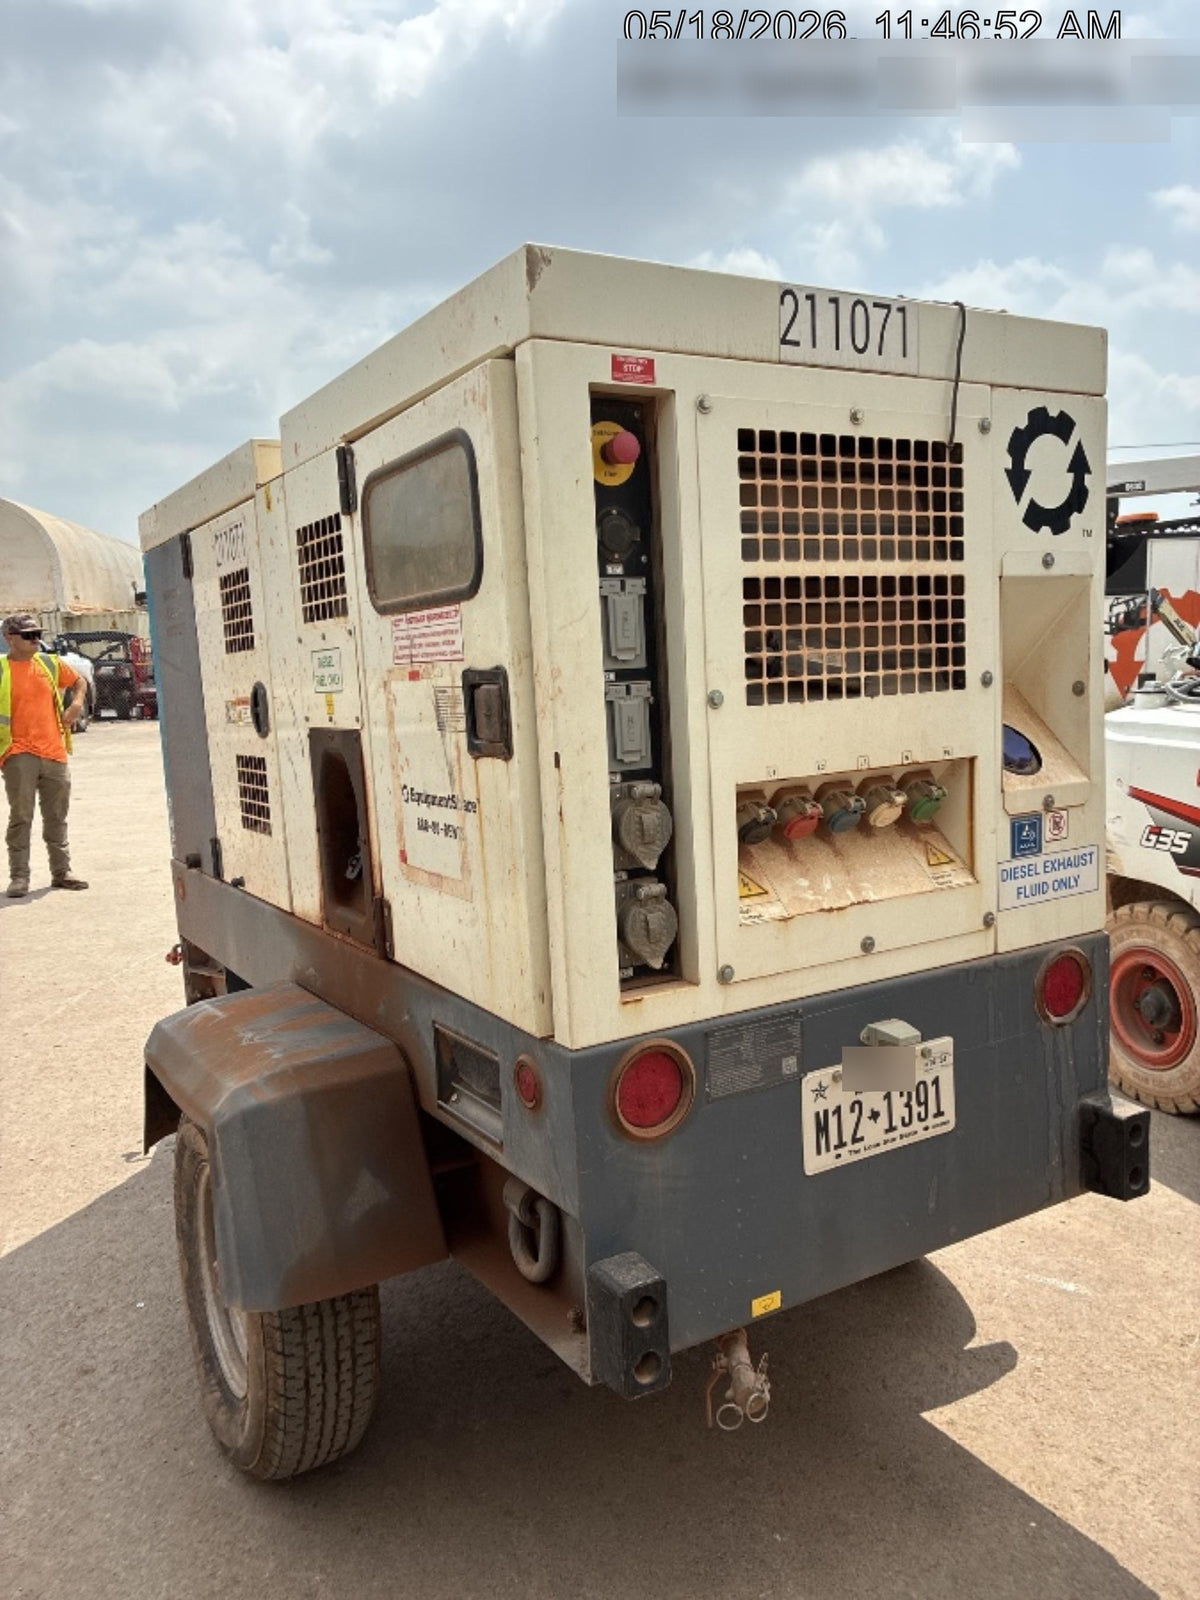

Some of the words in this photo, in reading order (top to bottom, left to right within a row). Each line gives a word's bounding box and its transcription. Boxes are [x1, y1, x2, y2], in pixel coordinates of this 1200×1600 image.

[780, 288, 907, 358] 211071
[1082, 528, 1093, 538] TM
[1000, 862, 1040, 883] DIESEL
[1043, 851, 1094, 874] EXHAUST
[1016, 881, 1050, 900] FLUID
[1052, 874, 1081, 892] ONLY
[814, 1098, 865, 1156] M12
